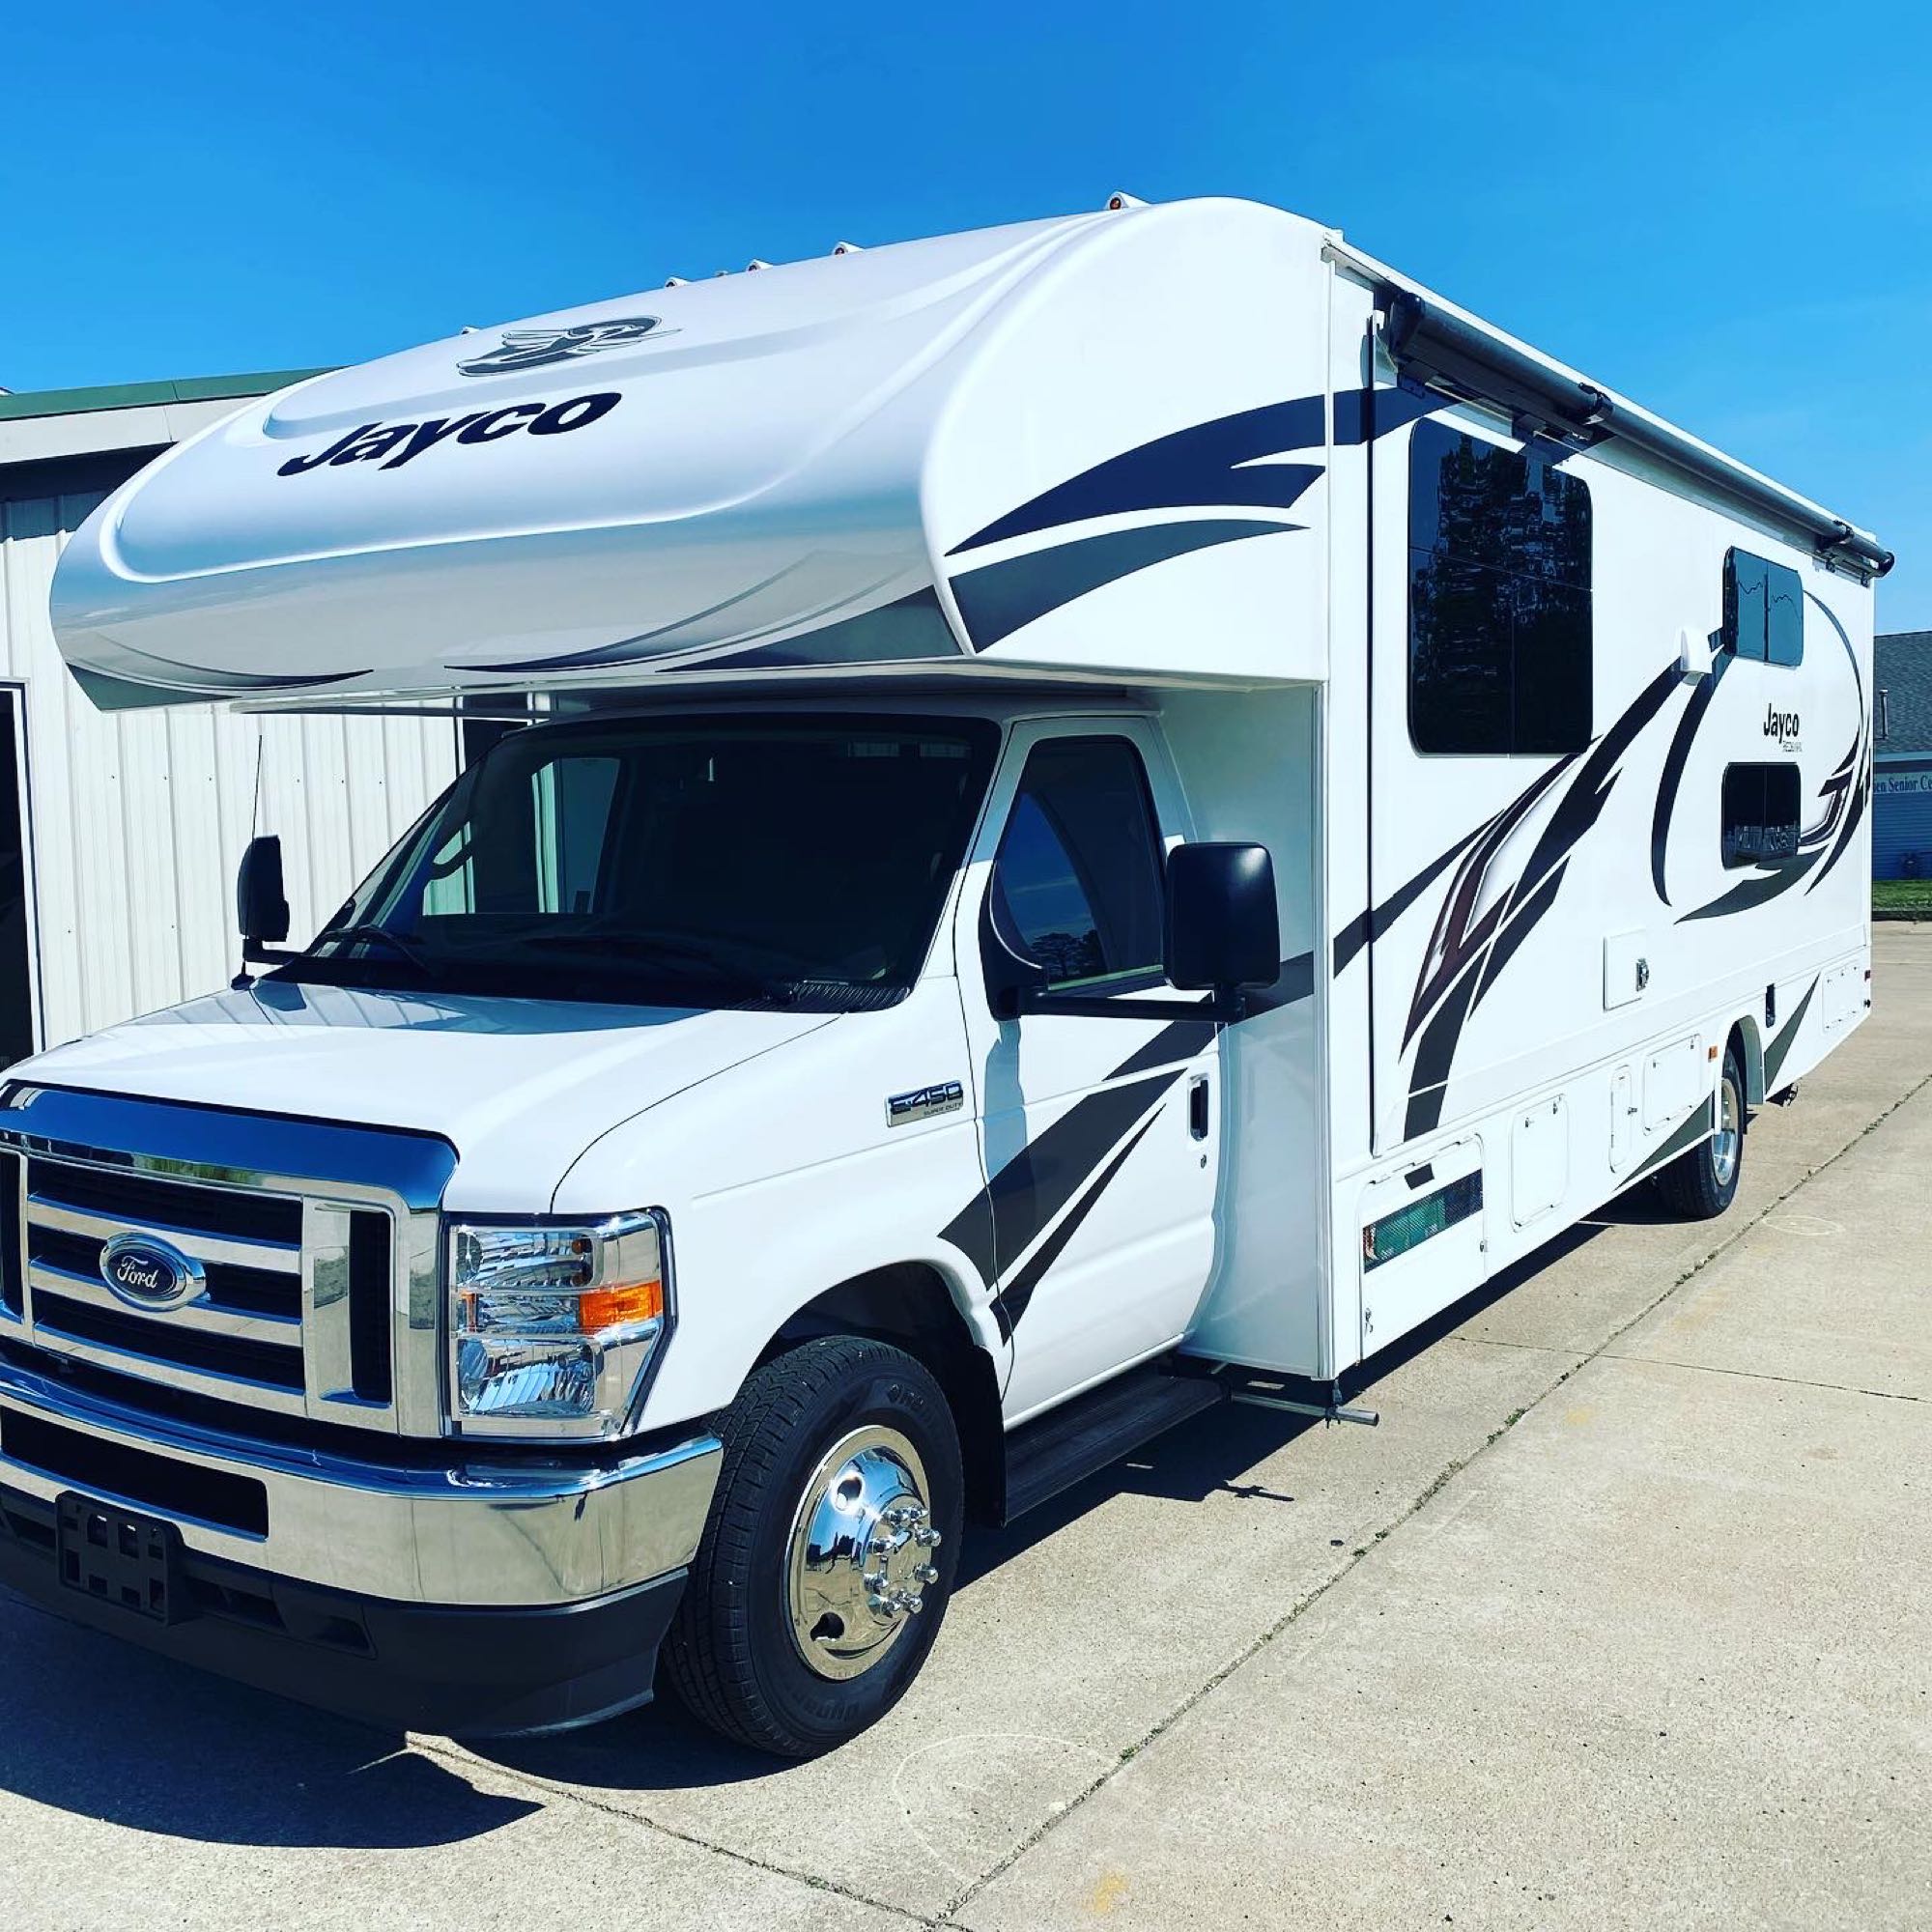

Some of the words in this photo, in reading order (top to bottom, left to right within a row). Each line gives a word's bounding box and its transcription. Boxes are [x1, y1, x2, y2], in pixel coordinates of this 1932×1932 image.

[276, 392, 622, 476] Jayco
[1763, 702, 1800, 744] Jayco
[1889, 777, 1918, 792] Senior
[888, 1080, 963, 1115] E-450
[117, 1255, 158, 1289] Ford
